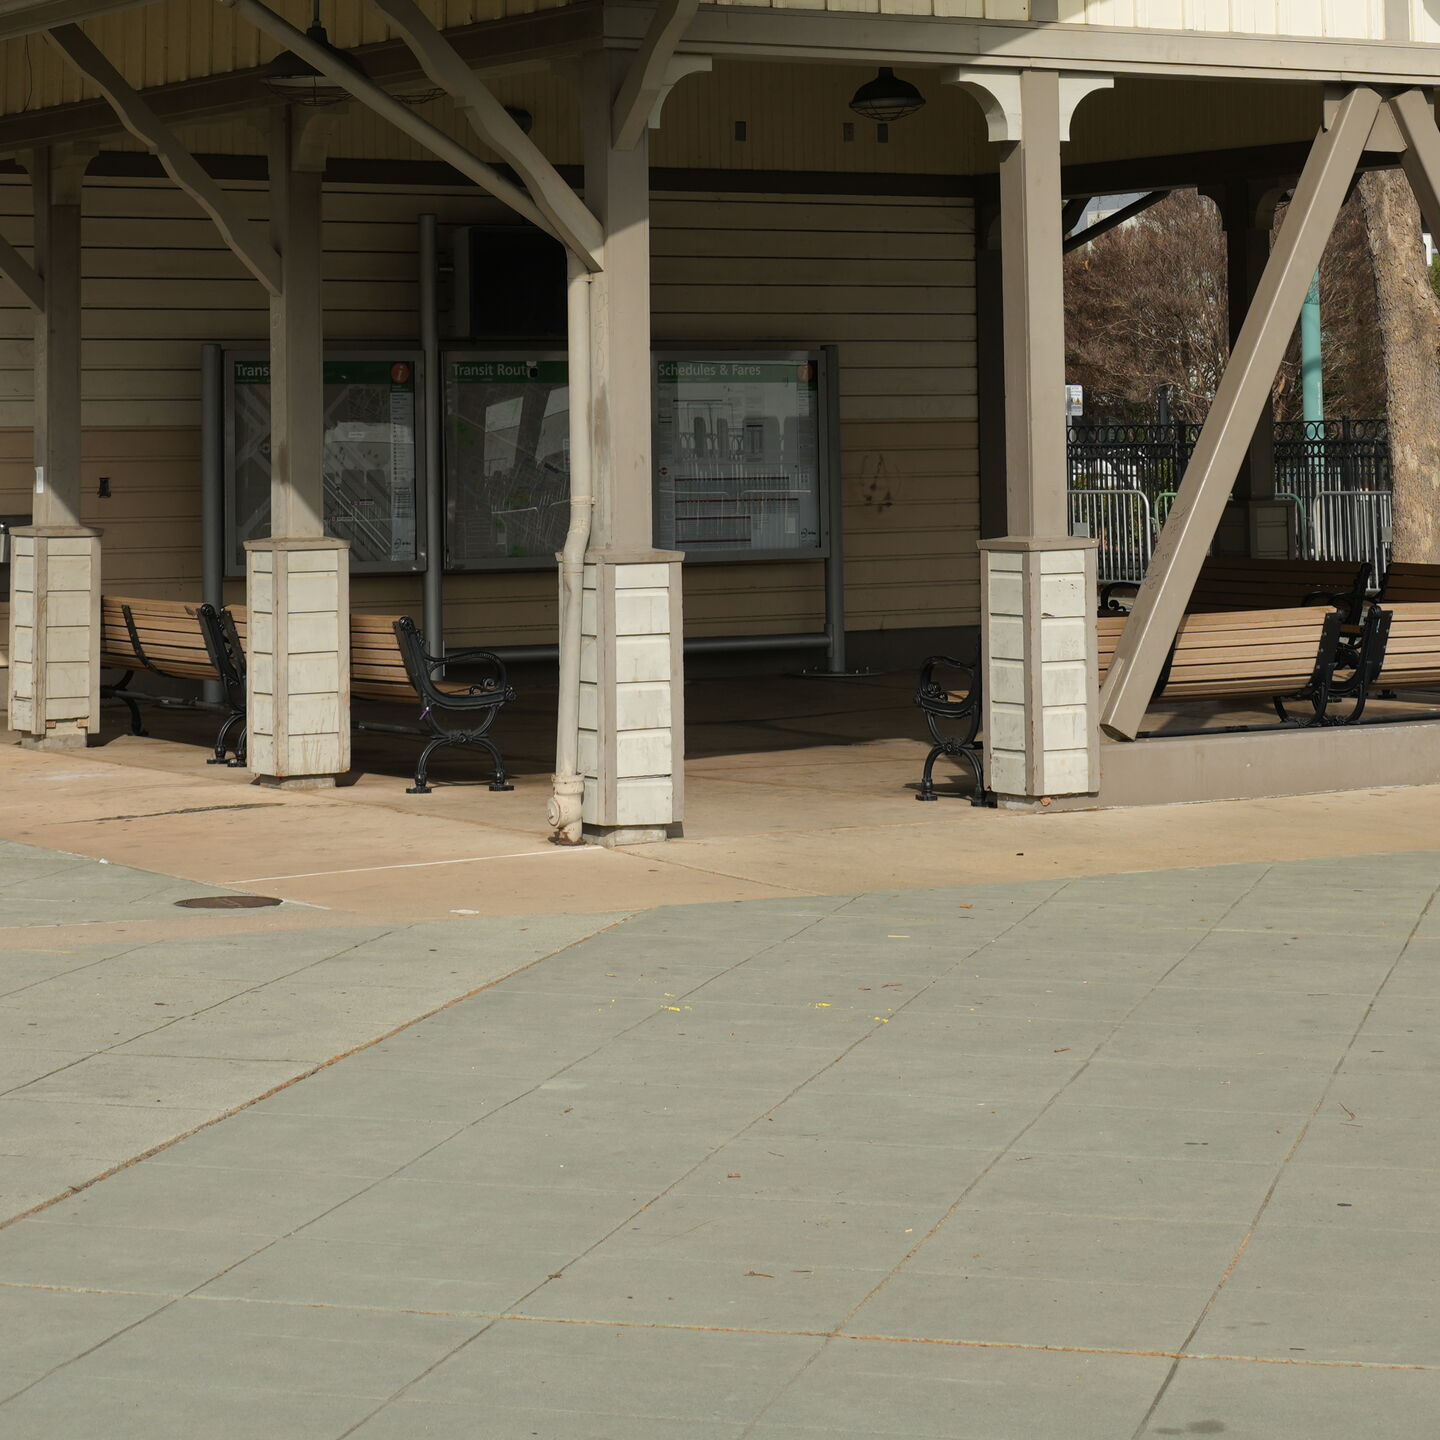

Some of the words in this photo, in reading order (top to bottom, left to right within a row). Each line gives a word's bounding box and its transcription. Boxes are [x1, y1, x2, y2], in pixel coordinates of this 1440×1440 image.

[235, 364, 271, 377] Trans
[452, 363, 493, 377] Transit
[497, 363, 528, 377] Rout
[658, 364, 716, 377] Schedules
[720, 364, 729, 376] &
[732, 364, 761, 376] Fares
